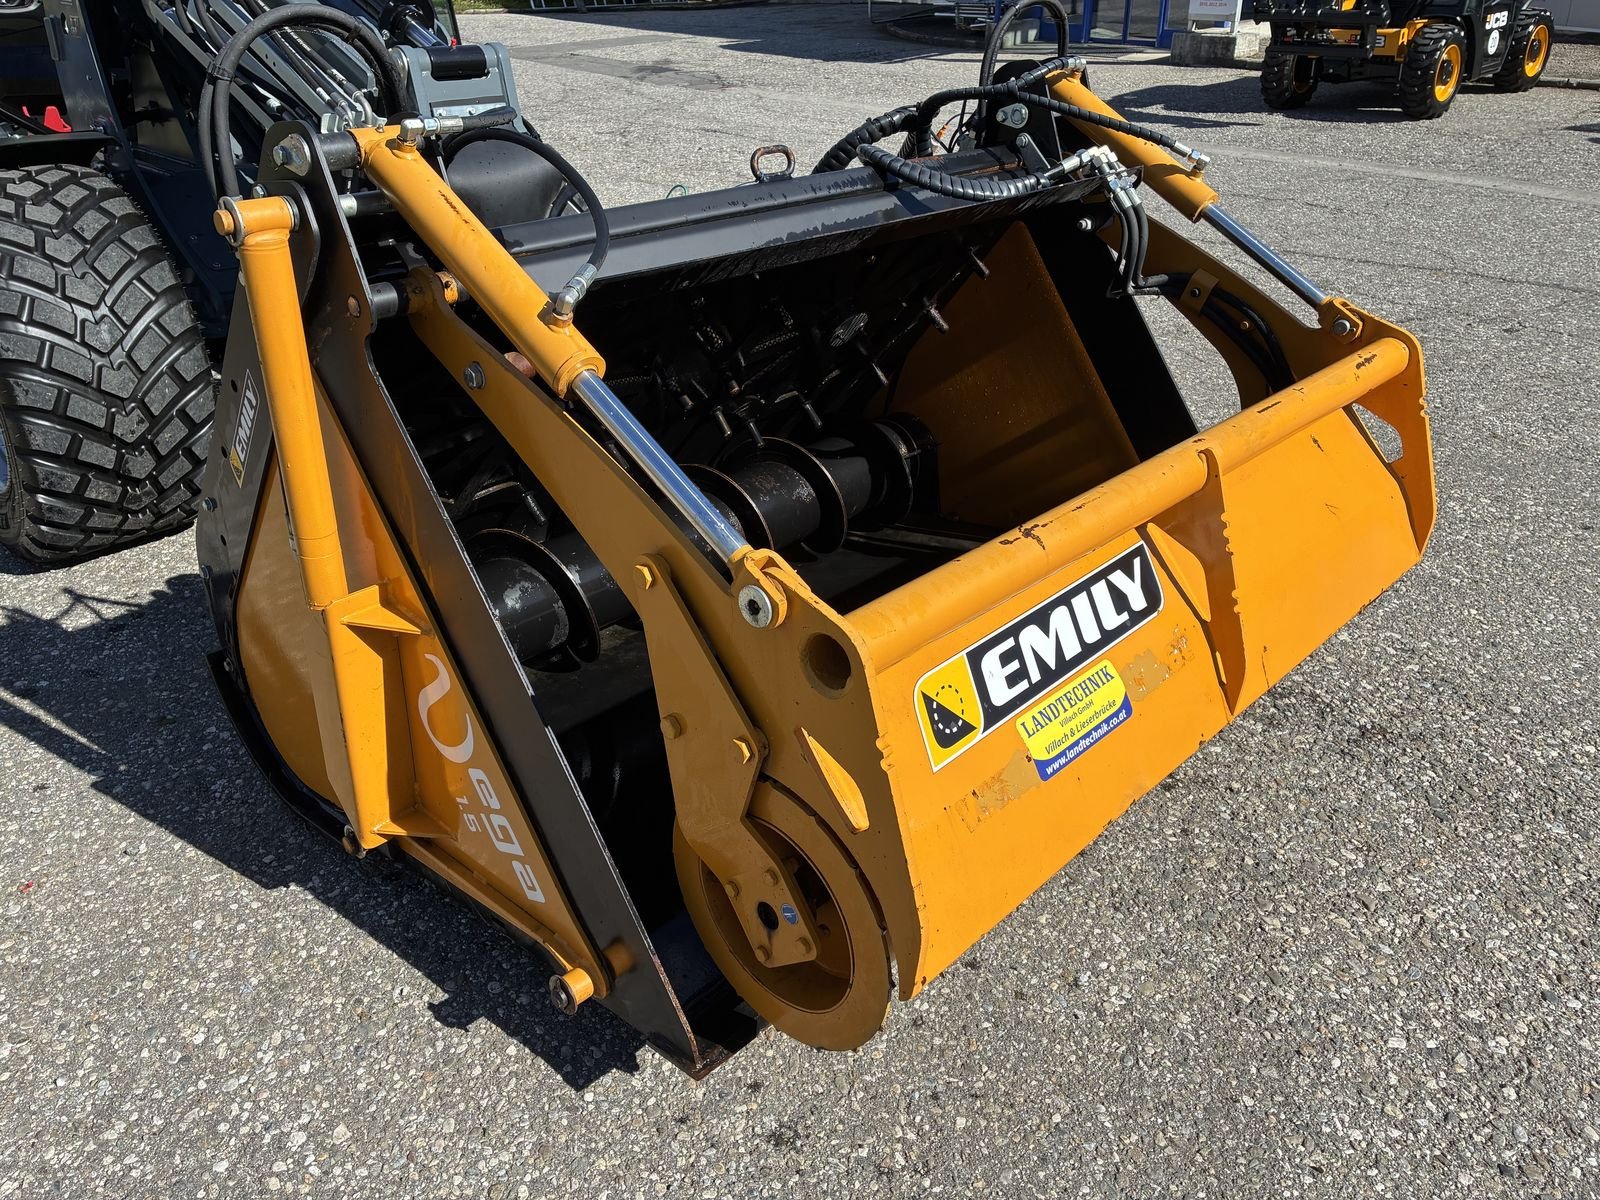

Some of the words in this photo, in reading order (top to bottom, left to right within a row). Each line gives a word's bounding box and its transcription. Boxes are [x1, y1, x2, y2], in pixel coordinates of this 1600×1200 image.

[1485, 10, 1508, 30] JCB
[235, 380, 257, 462] EMILY
[980, 556, 1147, 707] EMILY
[1020, 665, 1115, 739] LANDTECHNIK
[1045, 732, 1070, 755] Villach
[1070, 727, 1076, 738] &
[1076, 699, 1117, 733] Lieserbrücke
[1059, 711, 1078, 728] Villach
[1078, 699, 1095, 716] GmbH
[1046, 708, 1127, 775] www.landtechnik.co.at
[455, 794, 482, 833] 1.5
